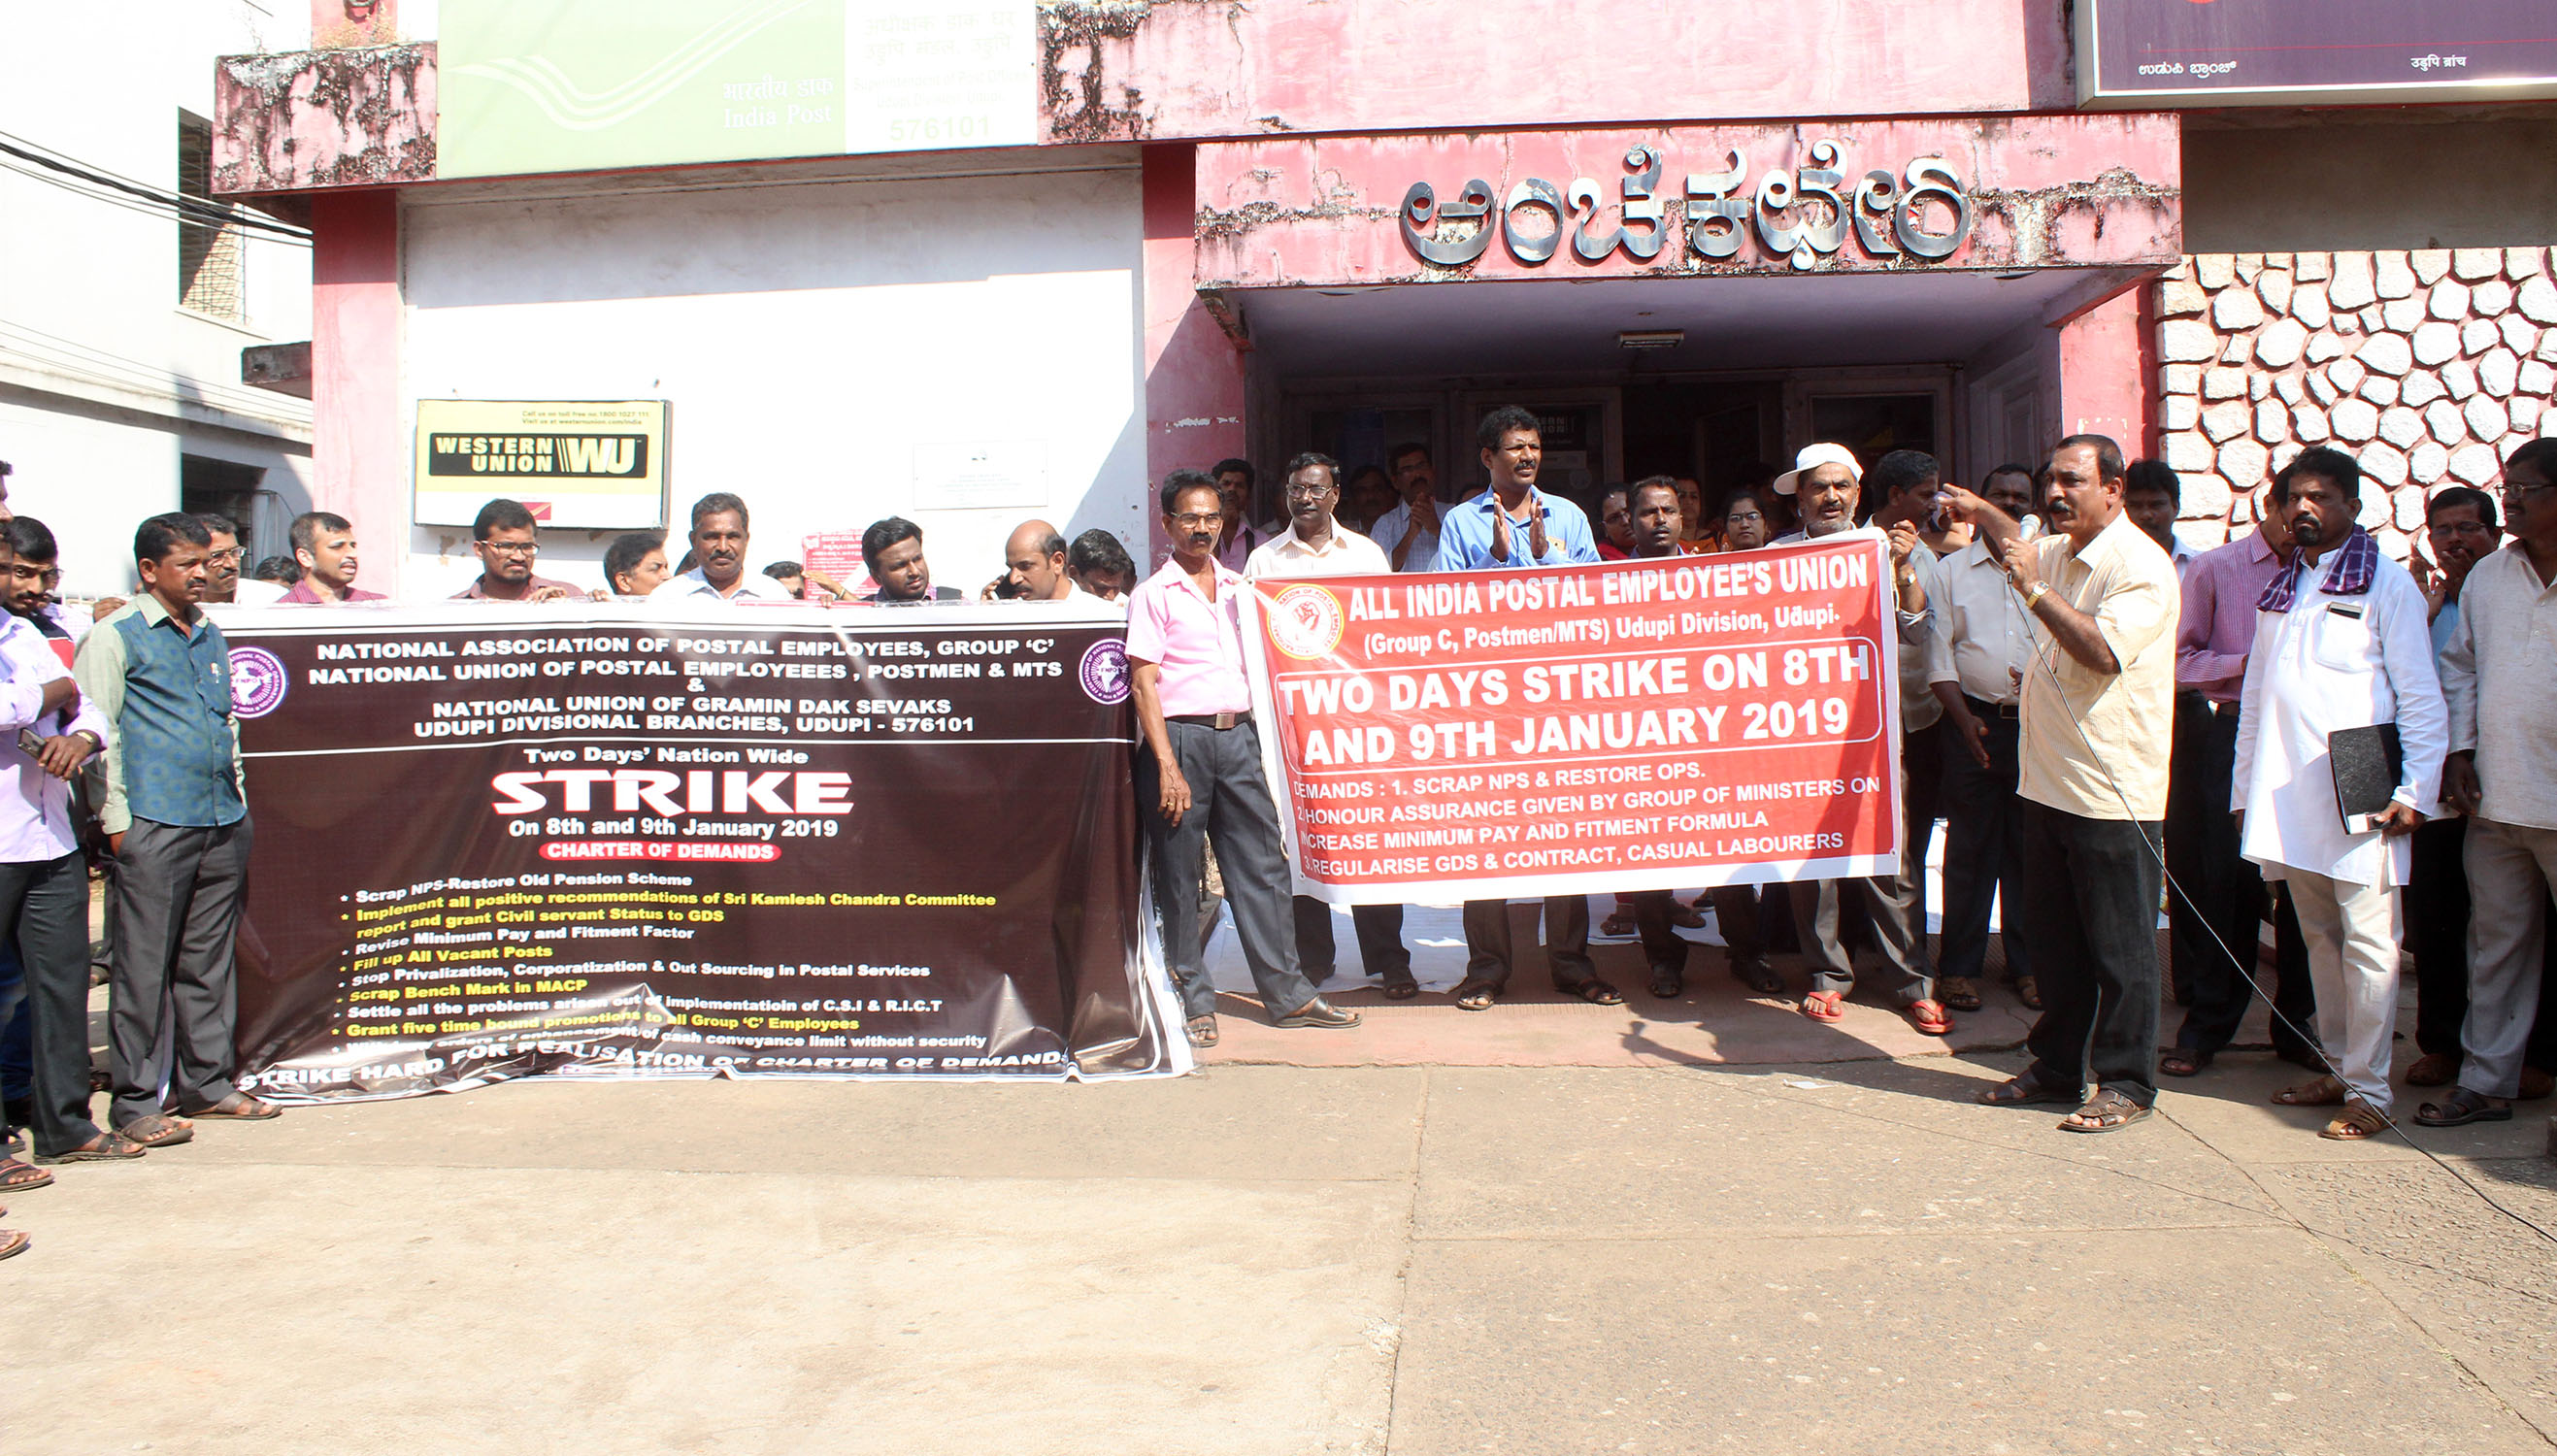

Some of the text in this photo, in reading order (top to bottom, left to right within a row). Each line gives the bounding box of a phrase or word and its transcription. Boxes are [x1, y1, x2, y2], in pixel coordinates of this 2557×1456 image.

[2138, 61, 2184, 76] ಉಡುಪಿ
[2410, 53, 2441, 72] उडुपि
[722, 73, 834, 101] भारतीय डाक
[723, 104, 832, 128] India Post
[1400, 144, 1668, 265] ಅಂಚೆ
[435, 437, 553, 454] WESTERN
[471, 454, 553, 473] UNION
[1348, 553, 1869, 622] ALL INDIA POSTAL EMPLOYEE'S UNION
[317, 637, 1054, 660] NATIONAL ASSOCIATION OF POSTAL EMPLOYEES, GROUP 'C'
[1365, 632, 1433, 661] (Group
[1438, 628, 1459, 655] C,
[1464, 617, 1611, 649] Postmen/MTS)
[1616, 613, 1676, 642] Udupi
[1681, 610, 1769, 635] Division,
[309, 659, 1063, 685] NATIONAL UNION OF POSTAL EMPLOYEEES POSTMEN & MTS
[1278, 644, 1870, 716] TWO DAYS STRIKE ON 8TH
[433, 696, 951, 718] NATIONAL UNION OF GRAMIN DAK SEVAKS
[414, 713, 974, 738] UDUPI DIVISIONAL BRANCHES, UDUPI 576101
[1305, 697, 1848, 766] AND 9TH JANUARY 2019
[523, 746, 810, 765] Two Days' Nation Wide
[492, 769, 854, 817] STRIKE
[1293, 761, 1706, 799] DEMANDS SCRAP NPS & RESTORE OPS.
[1305, 777, 1880, 825] HONOUR ASSURANCE GIVEN BY GROUP OF MINISTERS ON
[509, 816, 839, 841] On 8th and 9th January 2019
[1384, 828, 1475, 848] MINIMUM
[1479, 825, 1521, 844] PAY
[1526, 822, 1570, 842] AND
[1575, 816, 1663, 839] FITMENT
[1668, 811, 1770, 833] FORMULA
[547, 842, 775, 860] CHARTER OF DEMANDS
[1312, 832, 1844, 877] REGULARISE GDS & CONTRACT, CASUAL LABOURERS
[356, 872, 693, 904] Scrap NPS-Restore Old Pension Scheme
[357, 890, 996, 921] Implement all positive recommendations of Sri Kamlesh Chandra Committee
[357, 908, 725, 939] report and grant Civil servant Status to GDS
[356, 925, 695, 955] Revise Minimum Pay and Fitment Factor
[352, 960, 931, 987] Stop Privalization, Corporatization Out Sourcing in Postal Services
